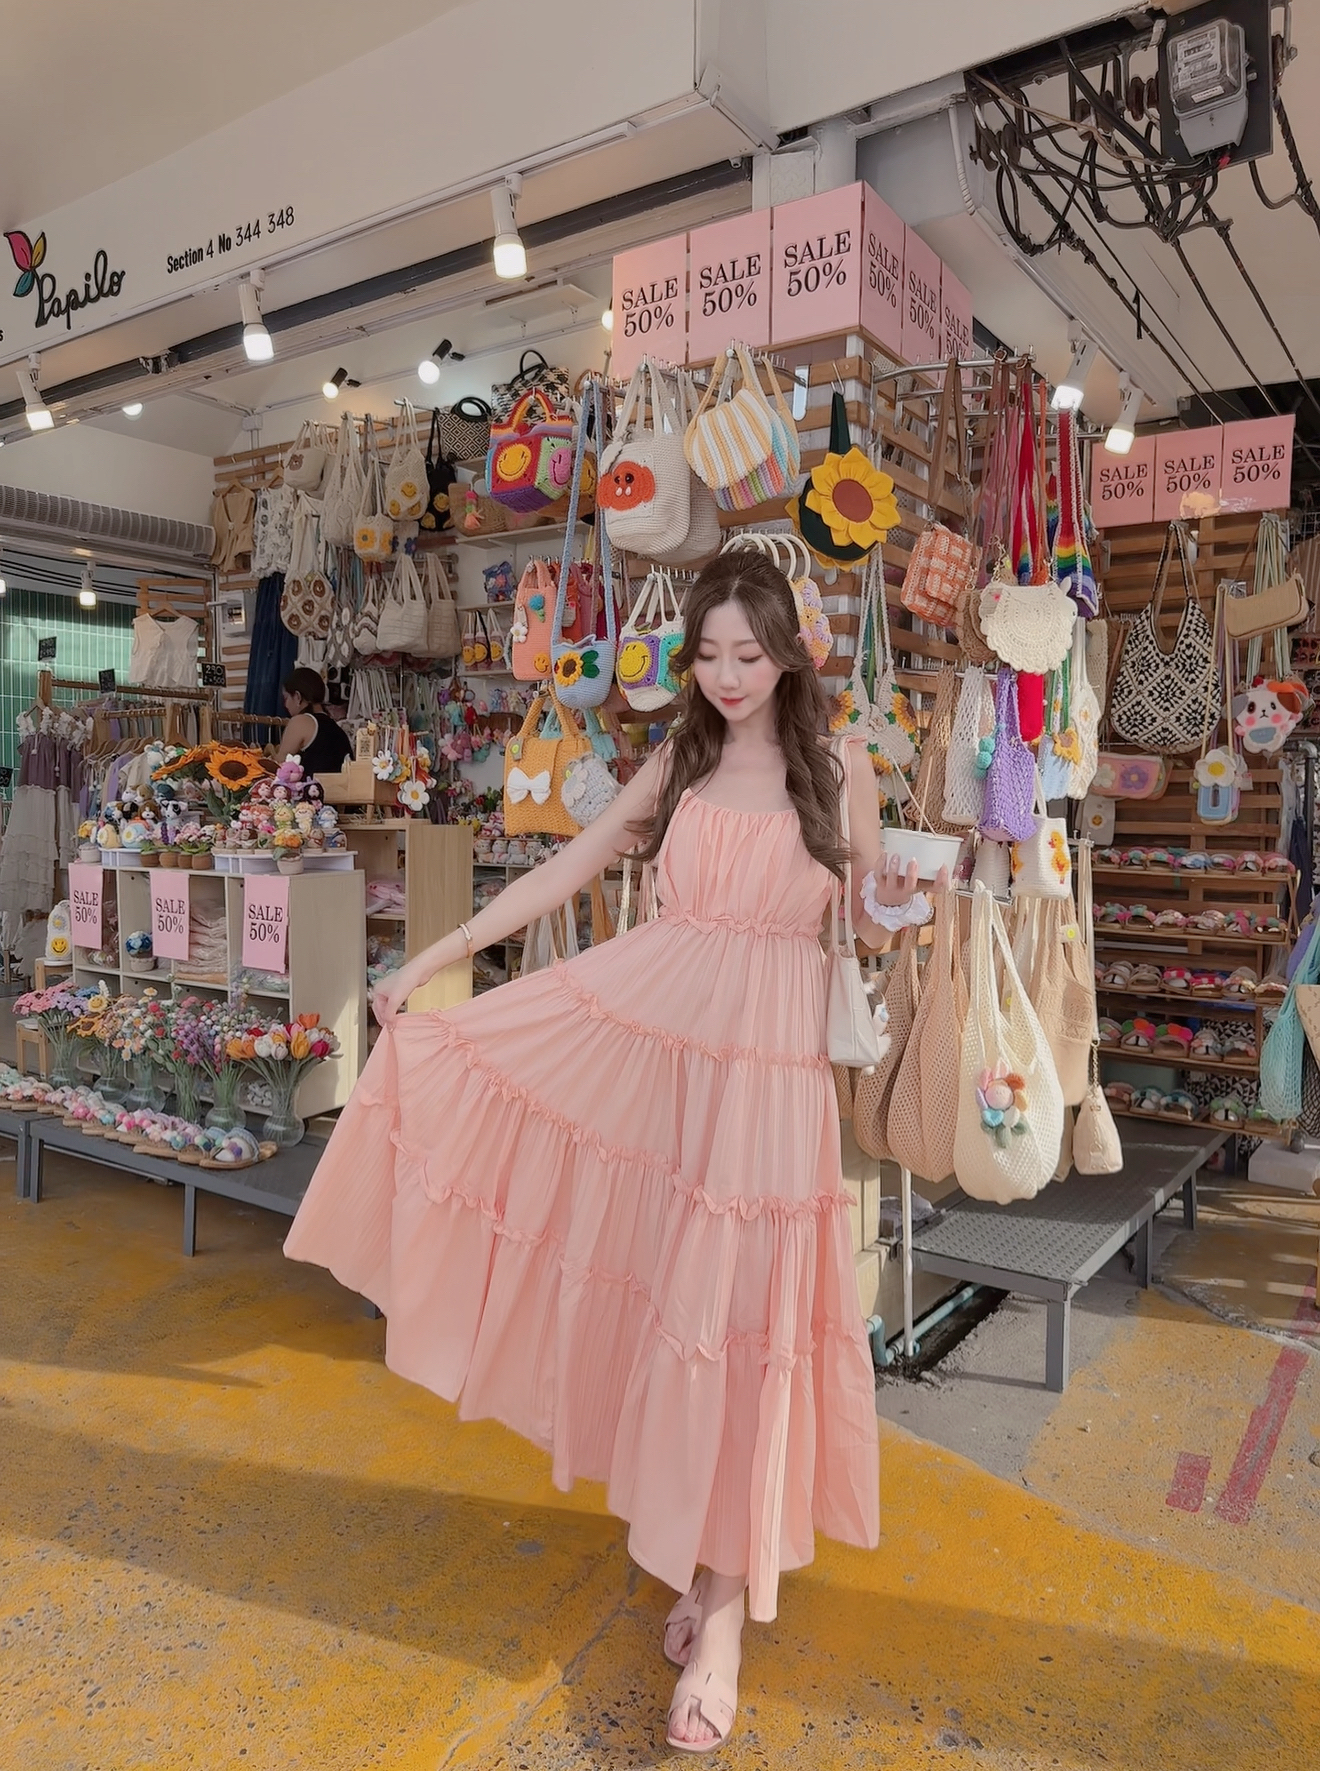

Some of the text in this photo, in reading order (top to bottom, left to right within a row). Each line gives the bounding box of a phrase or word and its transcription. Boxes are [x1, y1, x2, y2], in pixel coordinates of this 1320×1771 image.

[167, 206, 295, 274] Section 4 No 344 348
[784, 231, 852, 269] SALE
[868, 233, 899, 280] SALE
[699, 254, 762, 290] SALE
[787, 259, 847, 297] 50%
[869, 262, 897, 309] 50%
[35, 249, 126, 330] Papilo
[621, 278, 679, 312] SALE
[702, 281, 757, 317] 50%
[908, 270, 937, 314] SALE
[623, 303, 674, 338] 50%
[909, 298, 935, 340] 50%
[944, 306, 969, 347] SALE
[1163, 455, 1215, 475] SALE
[1231, 445, 1285, 465] SALE
[1100, 464, 1148, 482] SALE
[1166, 473, 1211, 493] 50%
[1233, 463, 1281, 484] 50%
[1102, 481, 1144, 501] 50%
[73, 890, 99, 907] SALE
[75, 906, 98, 925] 50%
[155, 898, 186, 915] SALE
[248, 904, 283, 923] SALE
[157, 915, 184, 934] 50%
[249, 922, 280, 943] 50%
